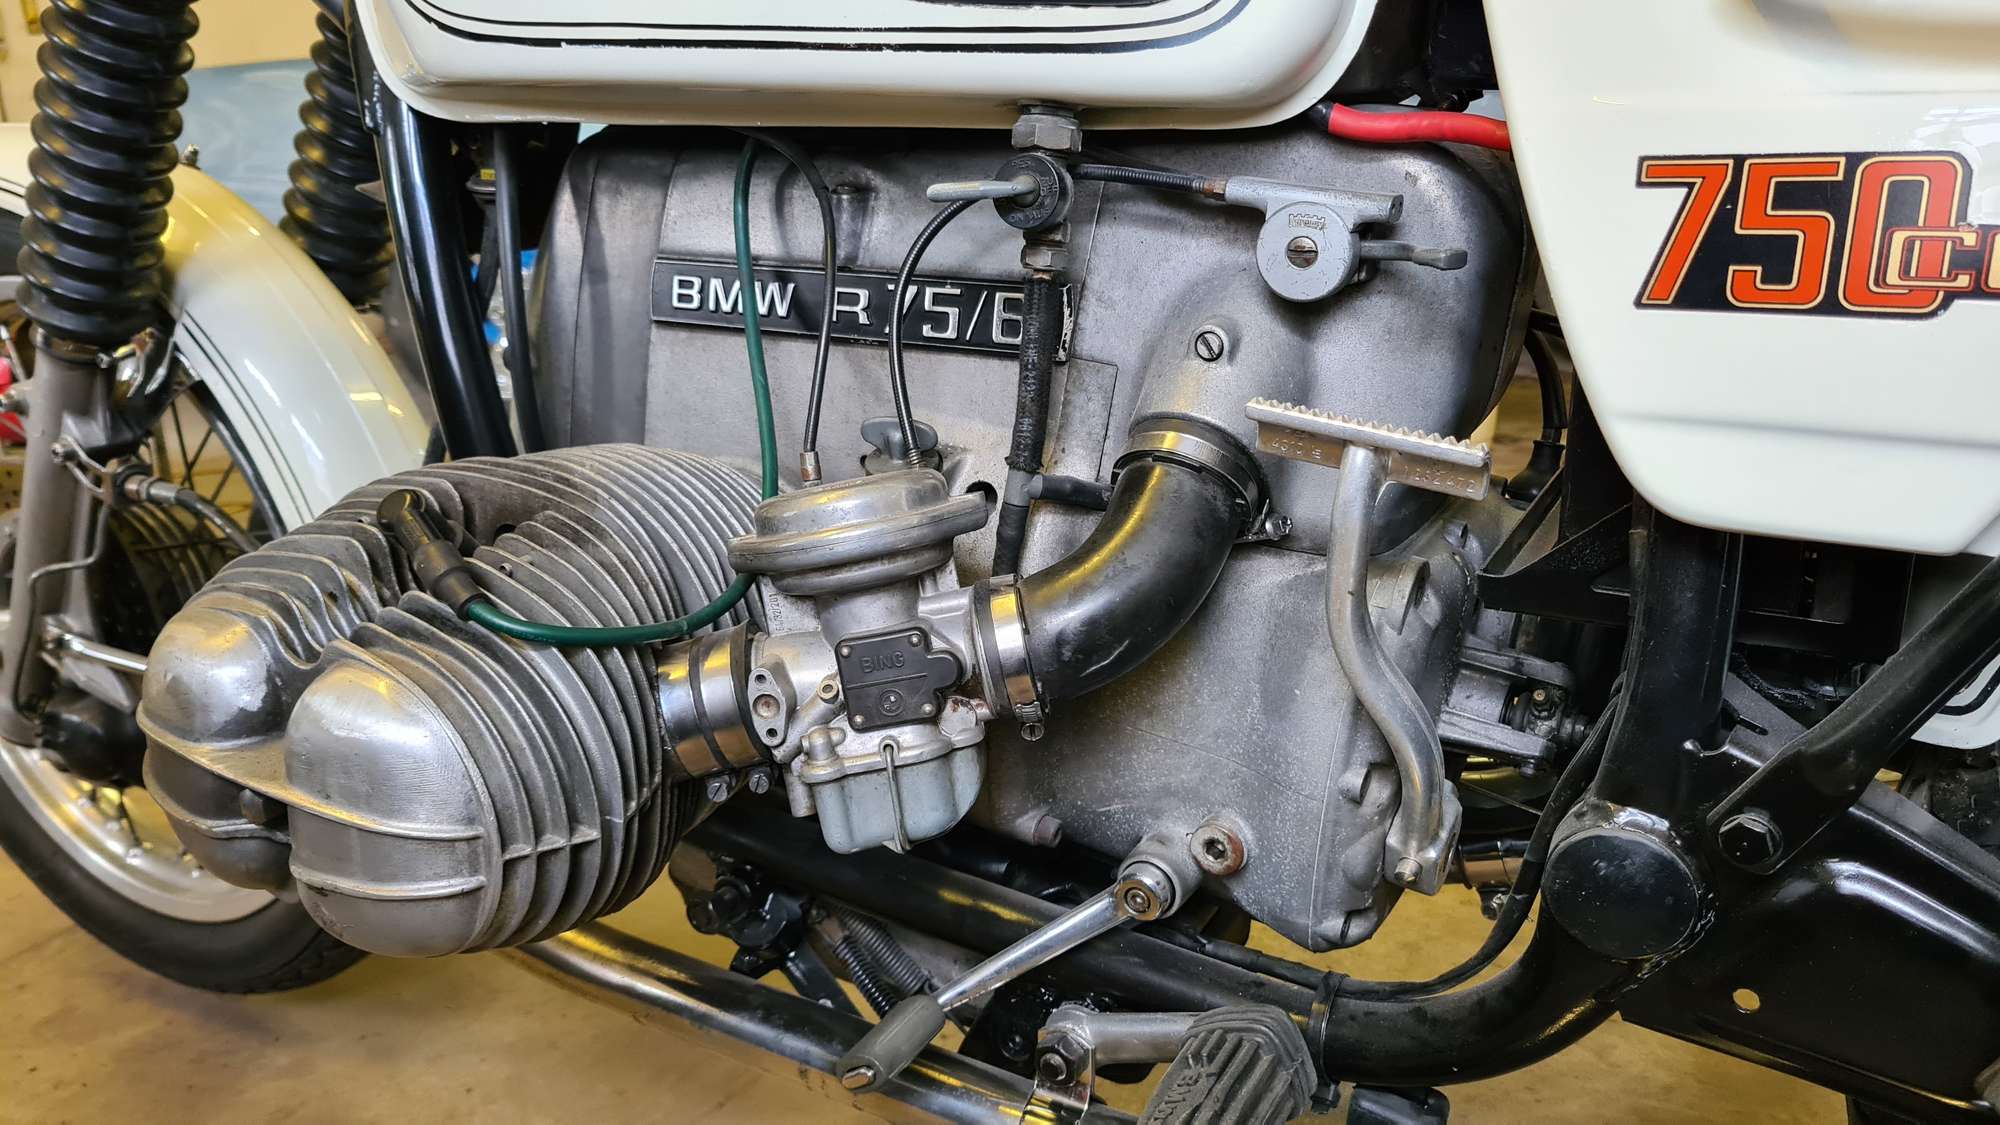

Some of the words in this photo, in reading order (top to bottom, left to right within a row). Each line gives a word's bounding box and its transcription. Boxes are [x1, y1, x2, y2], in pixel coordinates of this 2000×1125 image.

[1639, 154, 1965, 314] 750
[671, 274, 796, 318] BMW
[831, 286, 871, 326] R
[861, 651, 905, 673] BING
